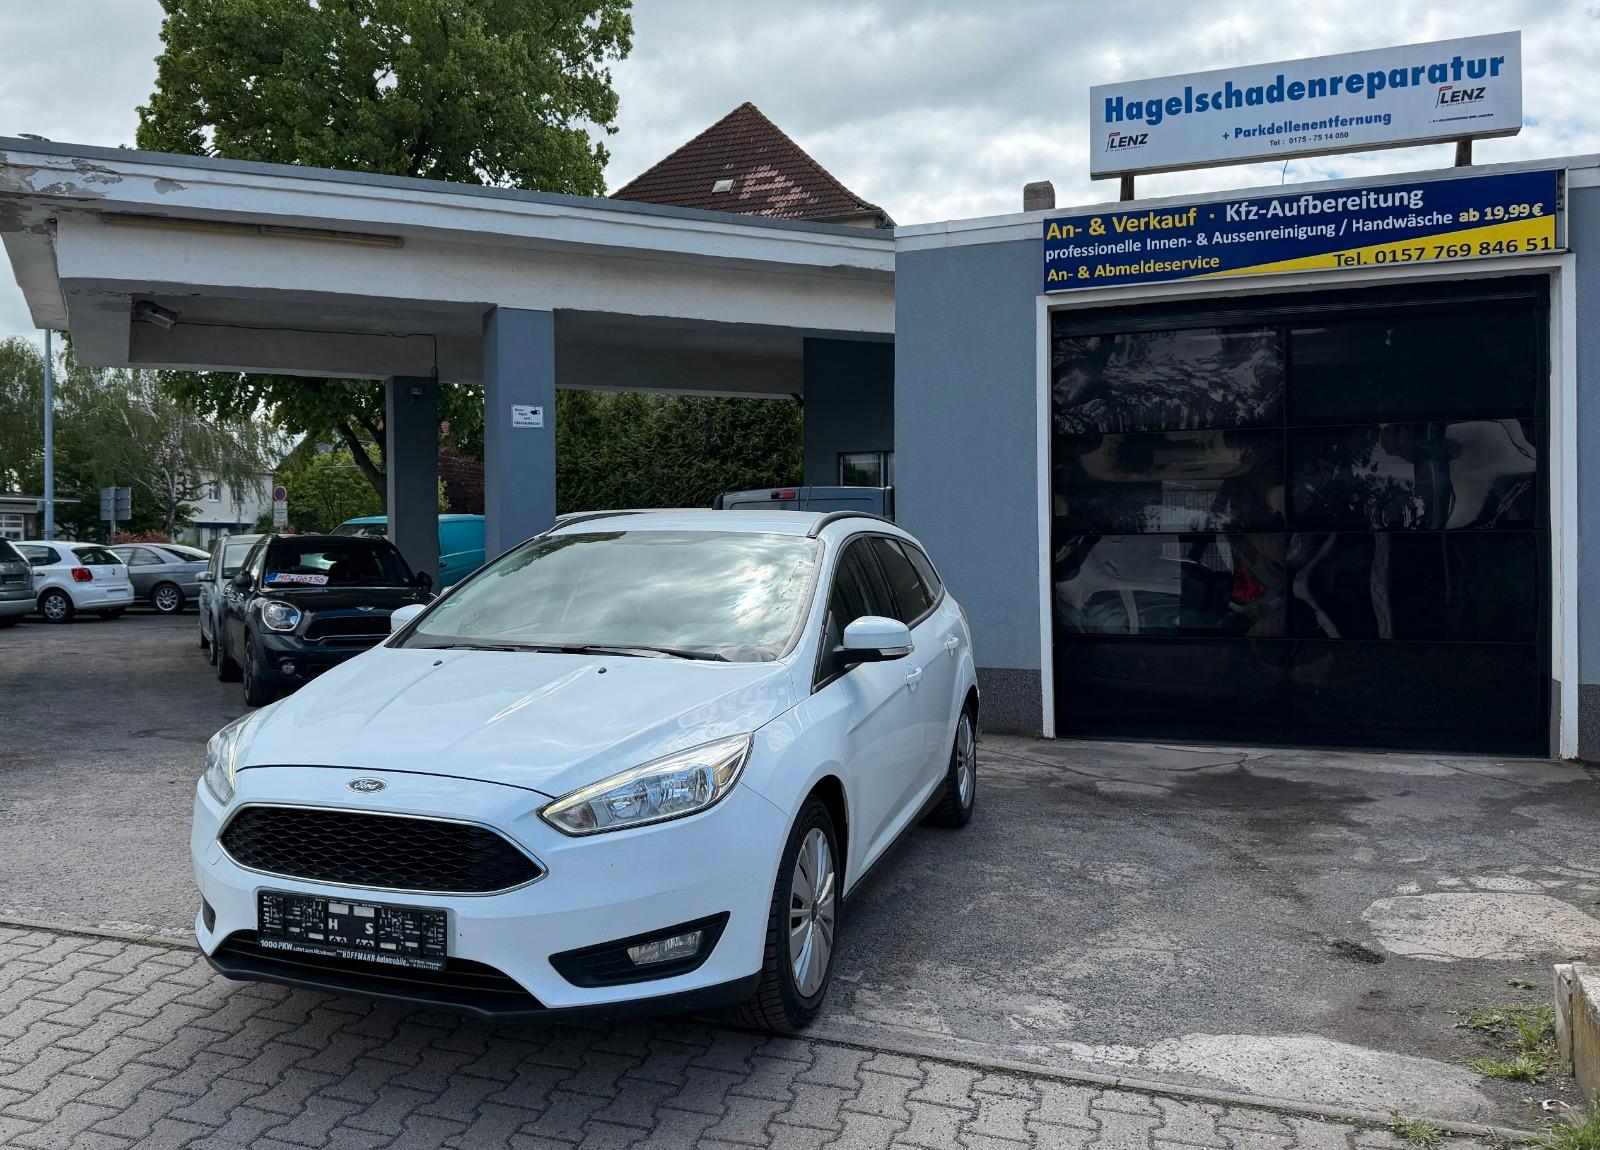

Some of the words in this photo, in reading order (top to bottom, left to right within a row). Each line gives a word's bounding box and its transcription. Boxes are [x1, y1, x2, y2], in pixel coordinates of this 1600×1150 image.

[1105, 54, 1505, 126] Hagelschadenreparatur
[1439, 86, 1487, 105] LENZ
[1234, 113, 1392, 139] Parkdellenentfernung
[1288, 135, 1307, 145] 0175
[1313, 134, 1323, 142] 75
[1324, 132, 1334, 141] 14
[1334, 131, 1349, 139] 050
[1109, 133, 1149, 149] LENZ
[1046, 222, 1083, 241] An-
[1088, 217, 1107, 236] &
[1111, 207, 1198, 234] Verkauf
[1226, 189, 1424, 223] Kfz-Aufbereitung
[1045, 239, 1142, 263] professionelle
[1146, 236, 1193, 251] Innen-
[1196, 232, 1208, 246] &
[1212, 223, 1336, 245] Aussenreinigung
[1352, 211, 1453, 233] Handwäsche
[1458, 208, 1480, 223] ab
[1332, 251, 1368, 268] Tel.
[1374, 247, 1426, 265] 0157
[1433, 242, 1472, 260] 769
[1478, 239, 1519, 256] 846
[1525, 236, 1552, 252] 51
[1047, 268, 1073, 283] An-
[1077, 265, 1091, 280] &
[1094, 256, 1220, 278] Abmeldeservice
[260, 939, 278, 949] 1000
[278, 941, 293, 951] PKW
